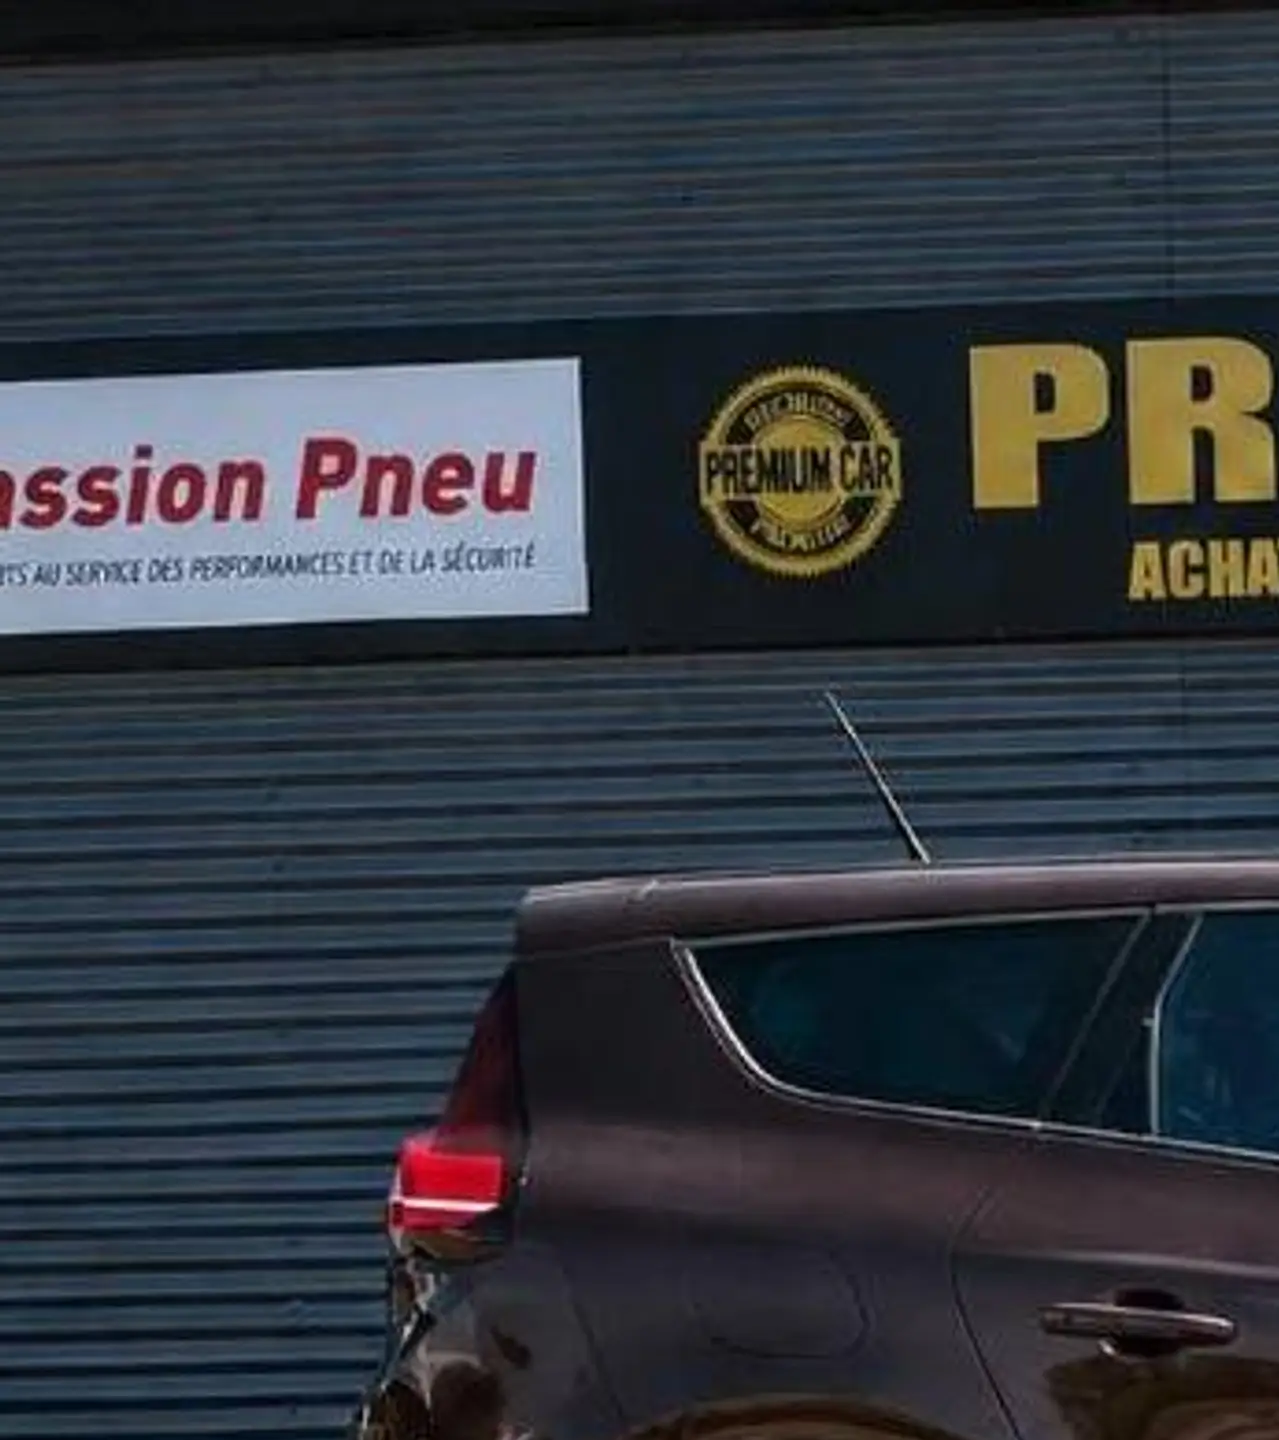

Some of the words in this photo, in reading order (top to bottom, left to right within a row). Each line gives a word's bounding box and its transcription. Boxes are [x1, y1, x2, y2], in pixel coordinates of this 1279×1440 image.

[0, 444, 266, 528] ssion
[297, 437, 535, 518] Pneu
[706, 446, 832, 494] PREMIUM
[840, 443, 893, 491] CAR
